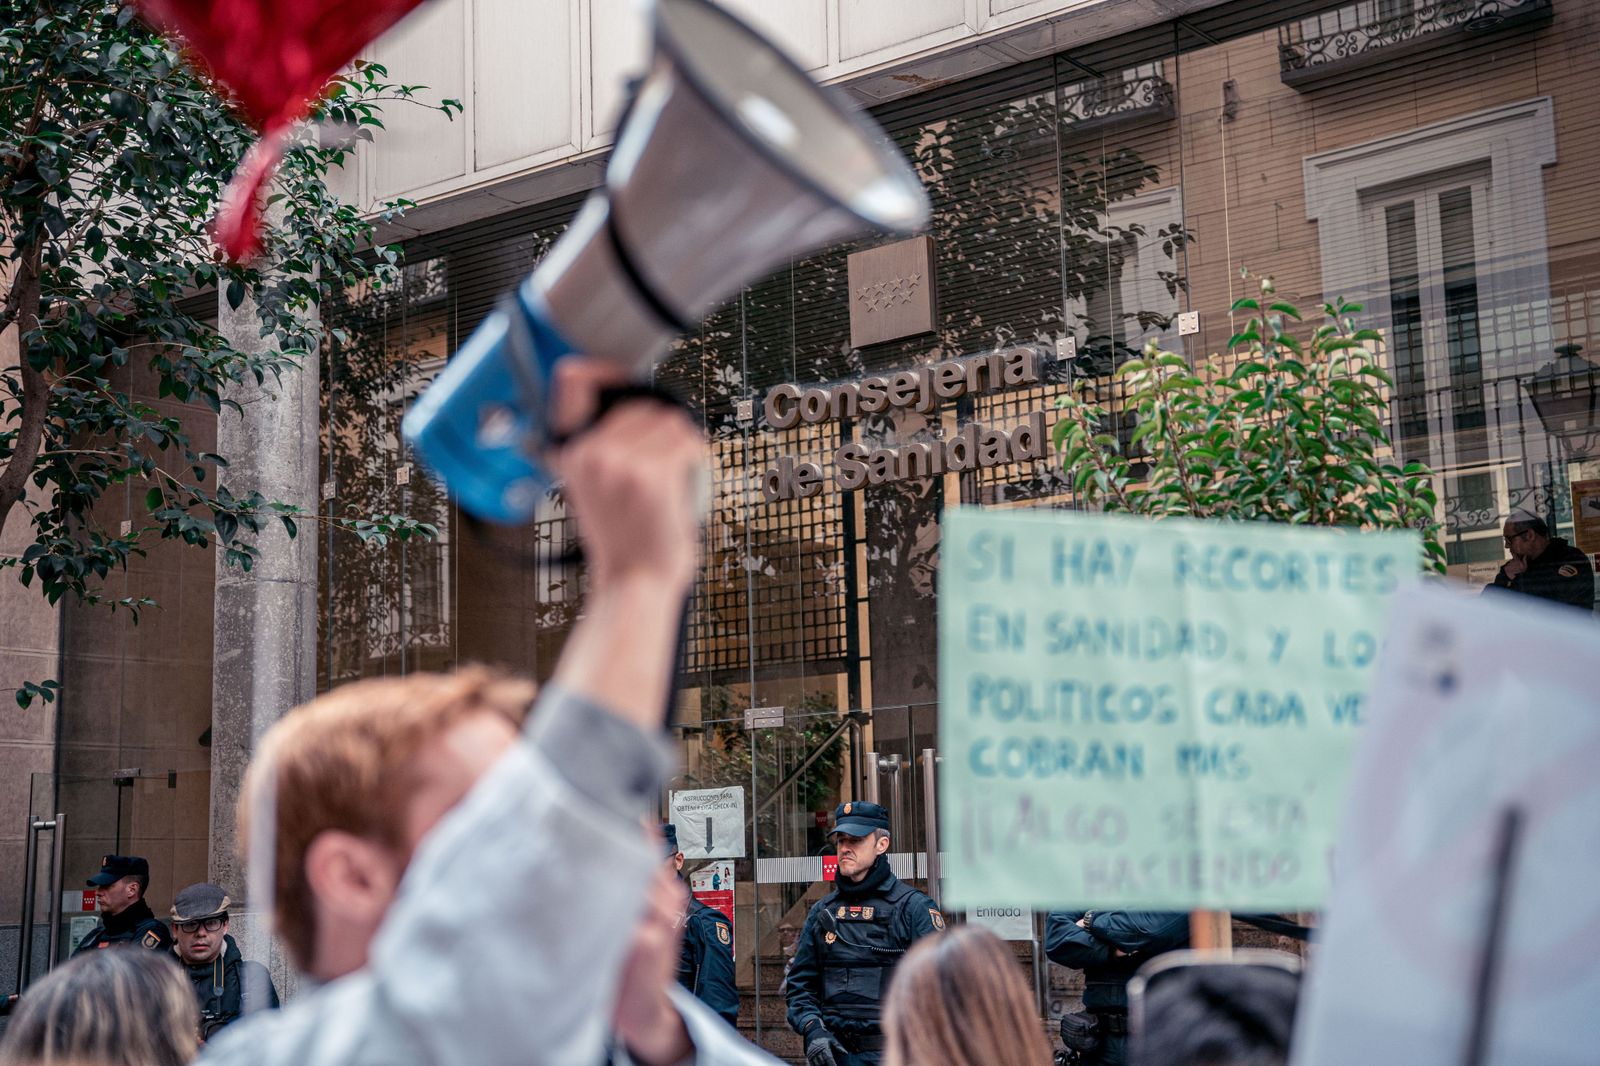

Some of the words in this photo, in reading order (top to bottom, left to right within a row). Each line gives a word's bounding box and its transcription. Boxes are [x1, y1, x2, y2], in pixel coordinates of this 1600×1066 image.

[762, 456, 824, 500] de
[835, 411, 1047, 491] Sanidad
[965, 529, 1017, 584] SI
[1050, 533, 1141, 588] HAY
[1172, 542, 1398, 594] RECORTES
[965, 603, 1028, 655] EN
[1266, 627, 1291, 666] Y
[1323, 629, 1382, 668] LO
[1204, 690, 1309, 728] CADA
[1327, 692, 1372, 726] VE
[966, 736, 1147, 780] COBRAN
[976, 905, 1021, 918] Entrada
